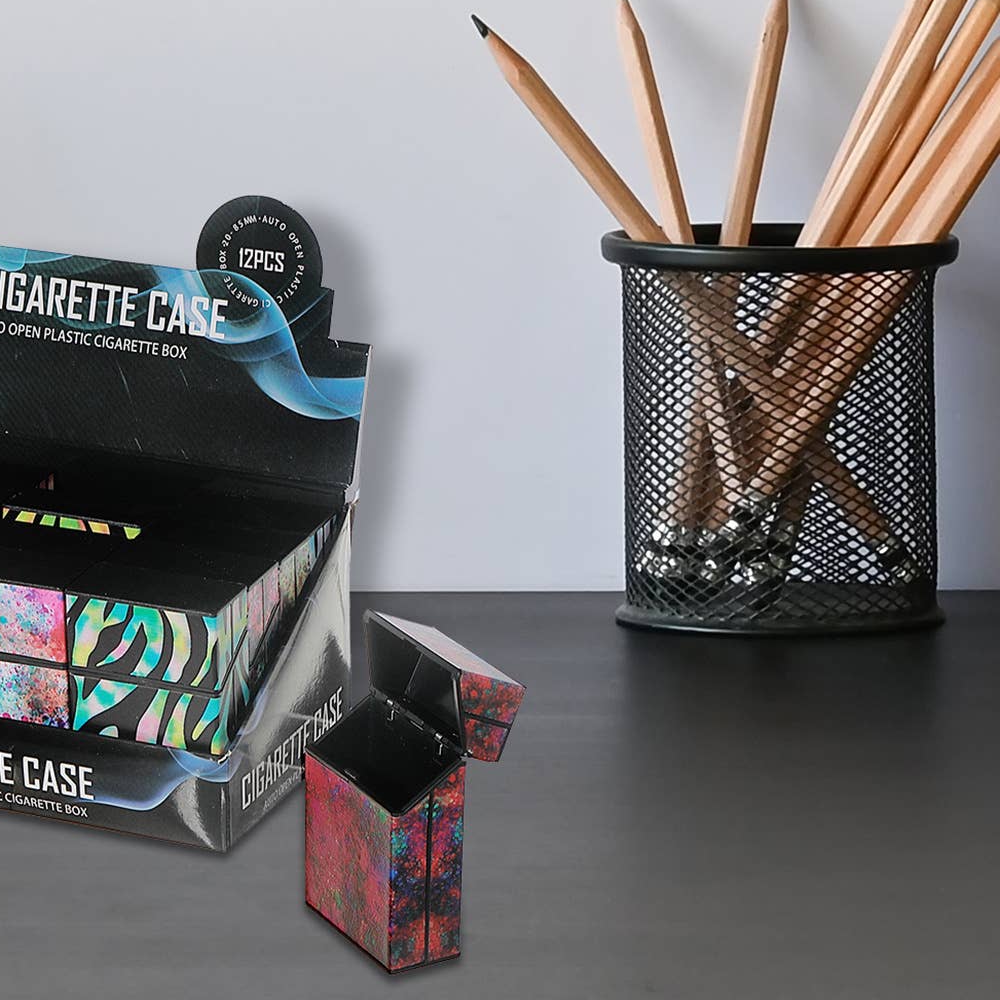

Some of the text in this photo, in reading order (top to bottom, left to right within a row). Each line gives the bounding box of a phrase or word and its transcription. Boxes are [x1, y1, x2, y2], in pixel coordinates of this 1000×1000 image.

[262, 215, 287, 231] AUTO
[218, 250, 228, 270] BOX
[239, 247, 285, 273] 12PCS
[288, 232, 305, 259] OPEN
[223, 275, 271, 308] CIGARETTE
[276, 264, 305, 304] PLASTIC
[146, 290, 229, 340] CASE
[8, 322, 41, 339] OPEN
[43, 328, 92, 347] PLASTIC
[93, 334, 159, 356] CIGARETTE
[161, 345, 188, 360] BOX
[313, 686, 343, 742] CASE
[22, 755, 95, 801] CASE
[4, 792, 63, 814] CIGARETTE
[64, 803, 89, 818] BOX
